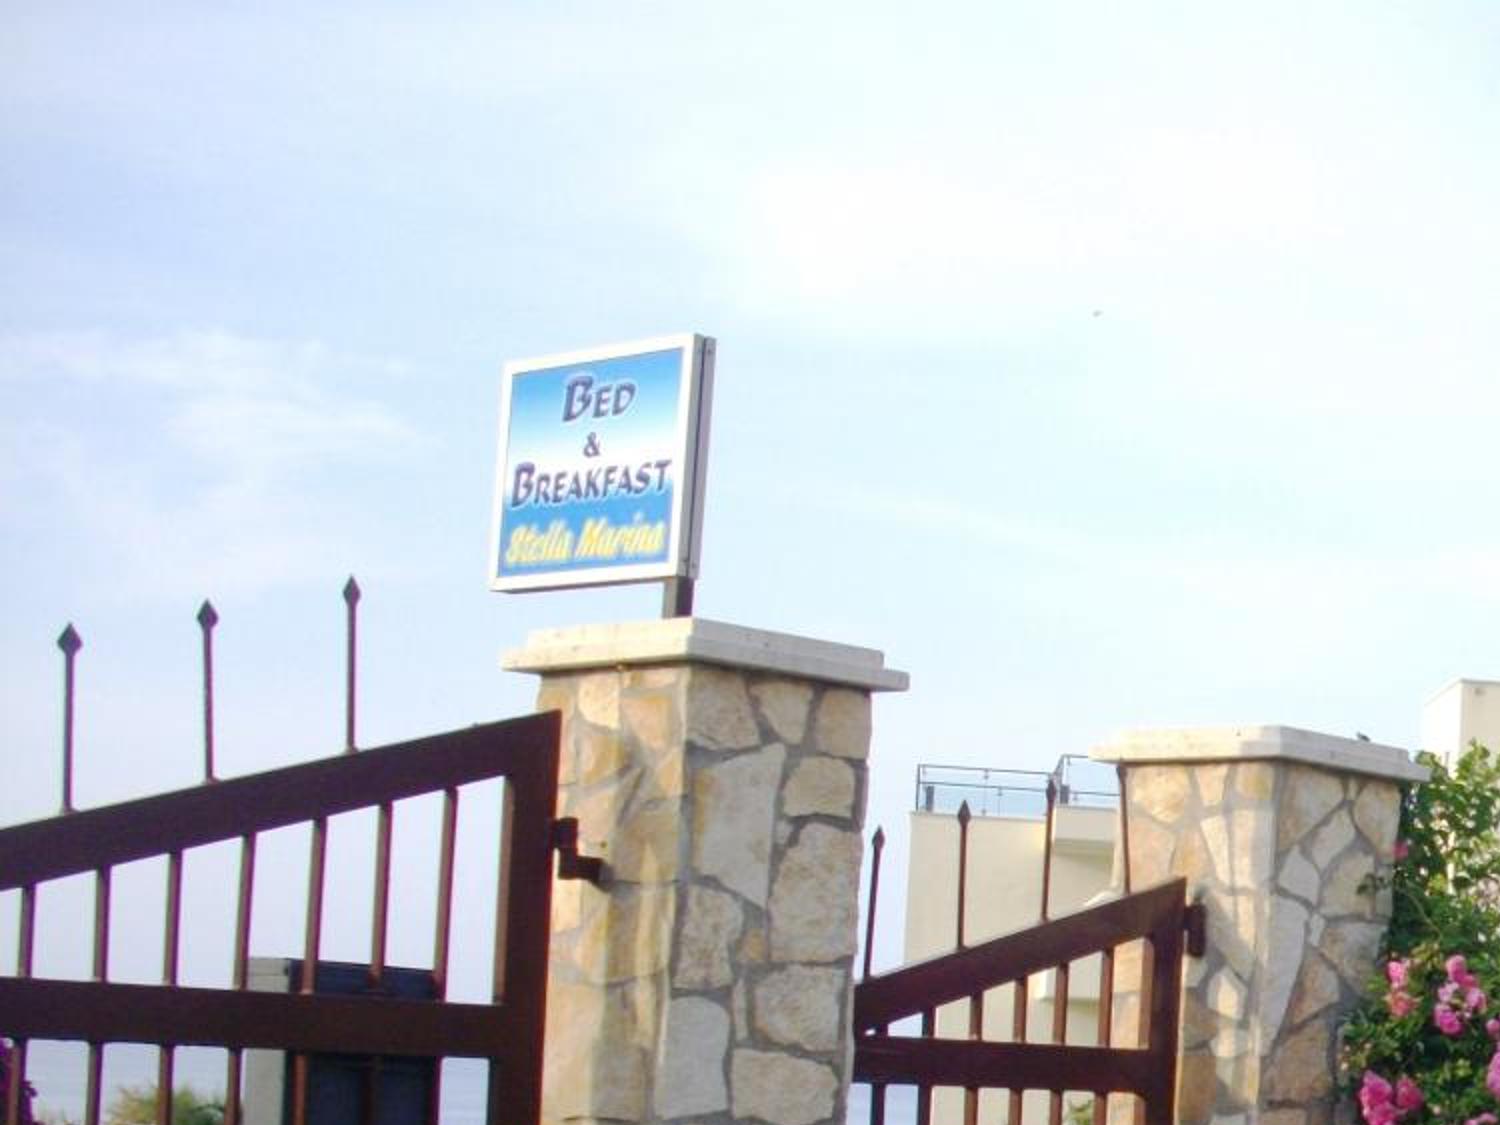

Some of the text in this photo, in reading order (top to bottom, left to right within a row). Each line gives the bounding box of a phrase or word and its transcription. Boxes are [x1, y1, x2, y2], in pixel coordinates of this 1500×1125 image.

[562, 375, 636, 422] BED
[583, 432, 601, 458] &
[511, 459, 672, 507] BREAKFAST
